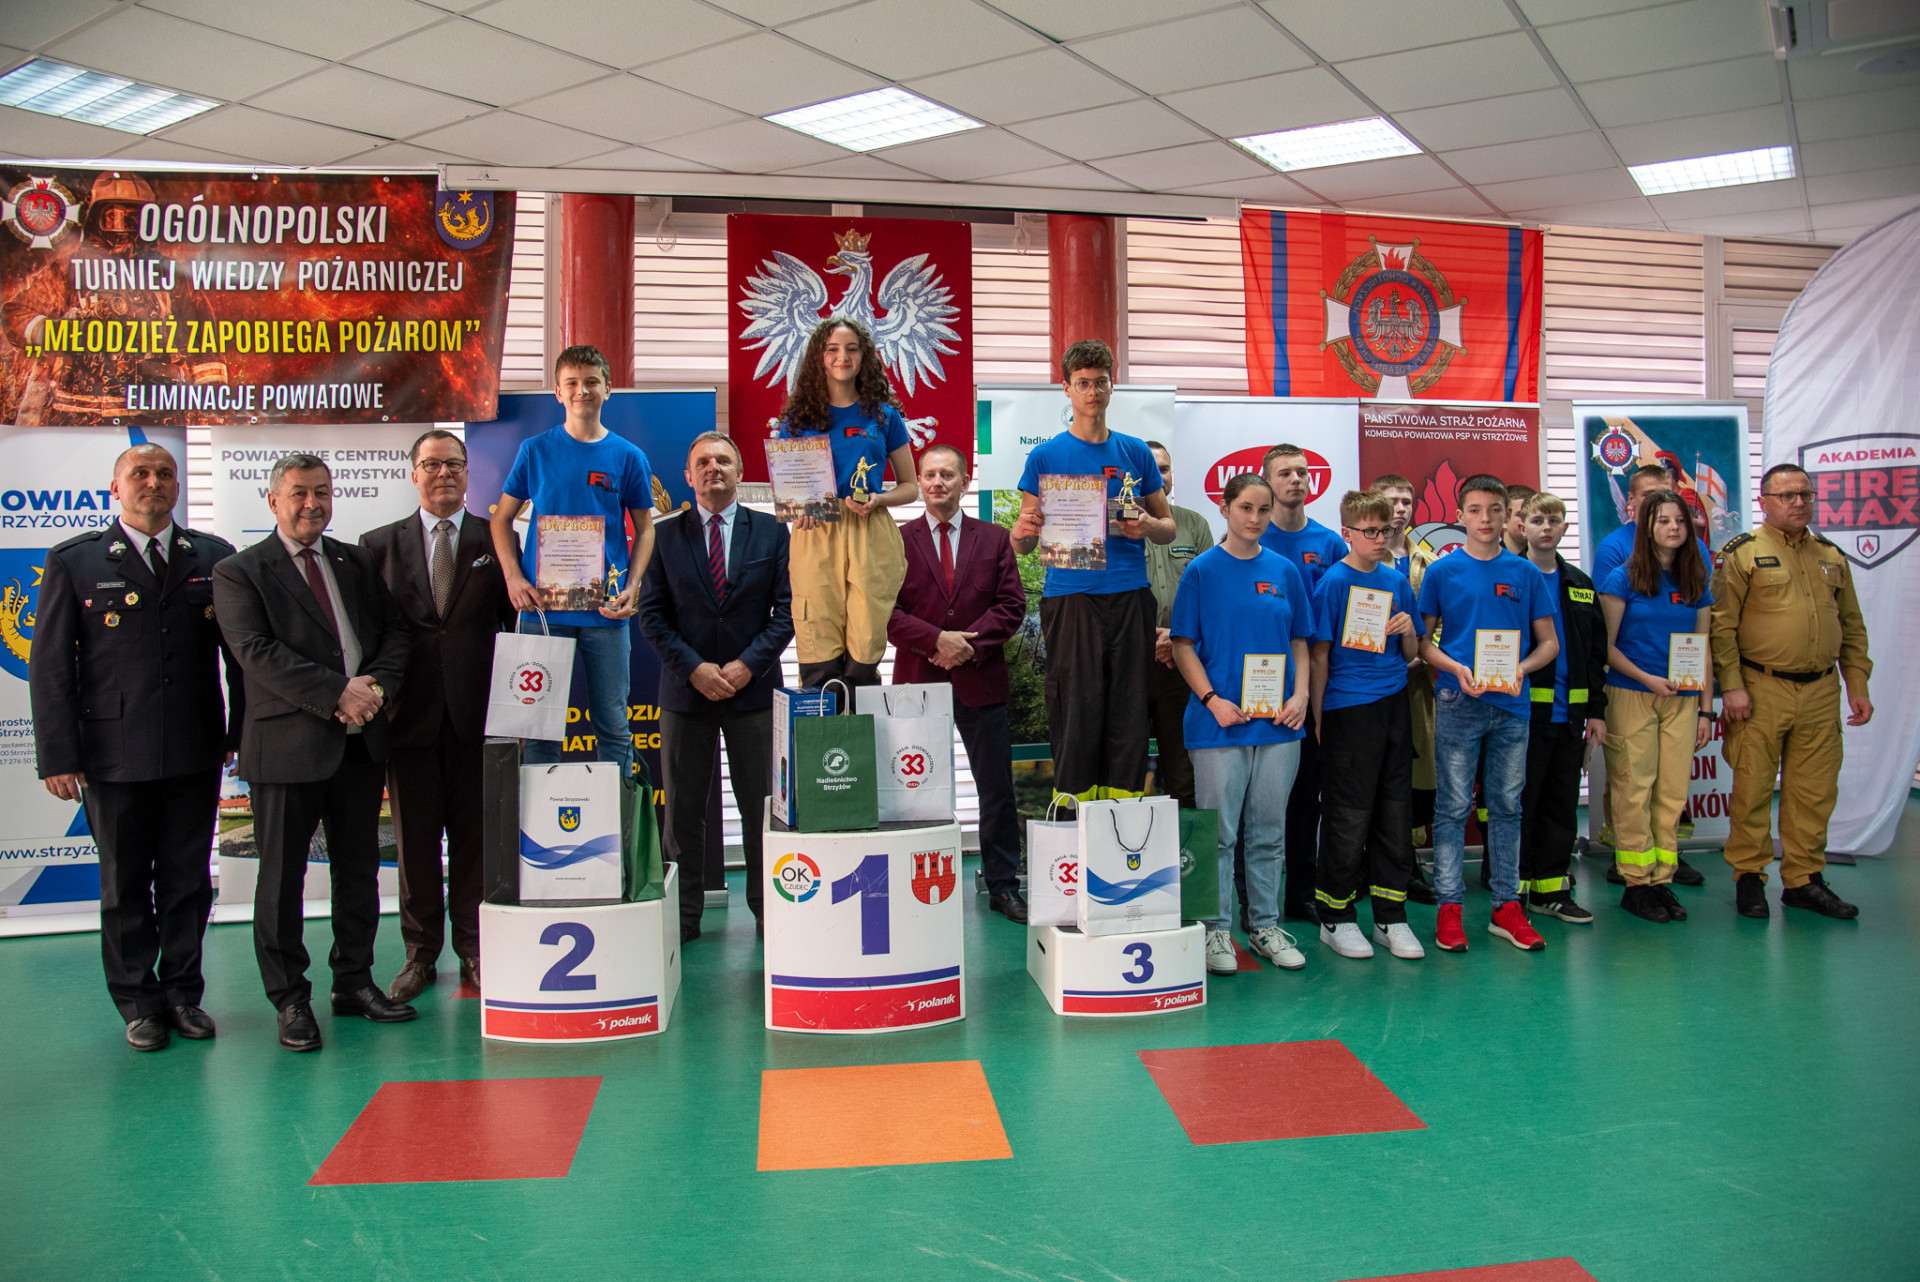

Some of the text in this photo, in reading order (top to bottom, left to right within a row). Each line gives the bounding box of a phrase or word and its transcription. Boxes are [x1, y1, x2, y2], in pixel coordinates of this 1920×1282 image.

[139, 195, 387, 244] OGÓLNOPOLSKI
[72, 256, 463, 292] TURNIEJ WIEDZY POŻARNICZEJ
[187, 320, 329, 354] ZAPOBIEGA
[339, 315, 481, 354] POŻAROM”
[127, 383, 384, 412] ELIMINACJE POWIATOWE
[1364, 412, 1527, 428] PAŃSTWOWA STRAŻ POŻARNA
[1020, 436, 1051, 444] Nadle
[1365, 429, 1528, 442] KOMENDA POWIATOWA PSP W STRZYŻOWIE
[1818, 447, 1916, 464] AKADEMIA
[1817, 468, 1919, 500] FIRE
[0, 511, 119, 528] RZYŻOWSKI
[1818, 496, 1920, 528] MAX
[519, 670, 544, 692] 33
[901, 753, 925, 775] 33
[782, 867, 810, 882] OK
[831, 854, 890, 956] 1
[539, 921, 597, 992] 2
[1121, 942, 1155, 984] 3
[918, 993, 956, 1011] polanik
[1164, 991, 1200, 1008] polanik
[609, 1013, 653, 1031] polanik
